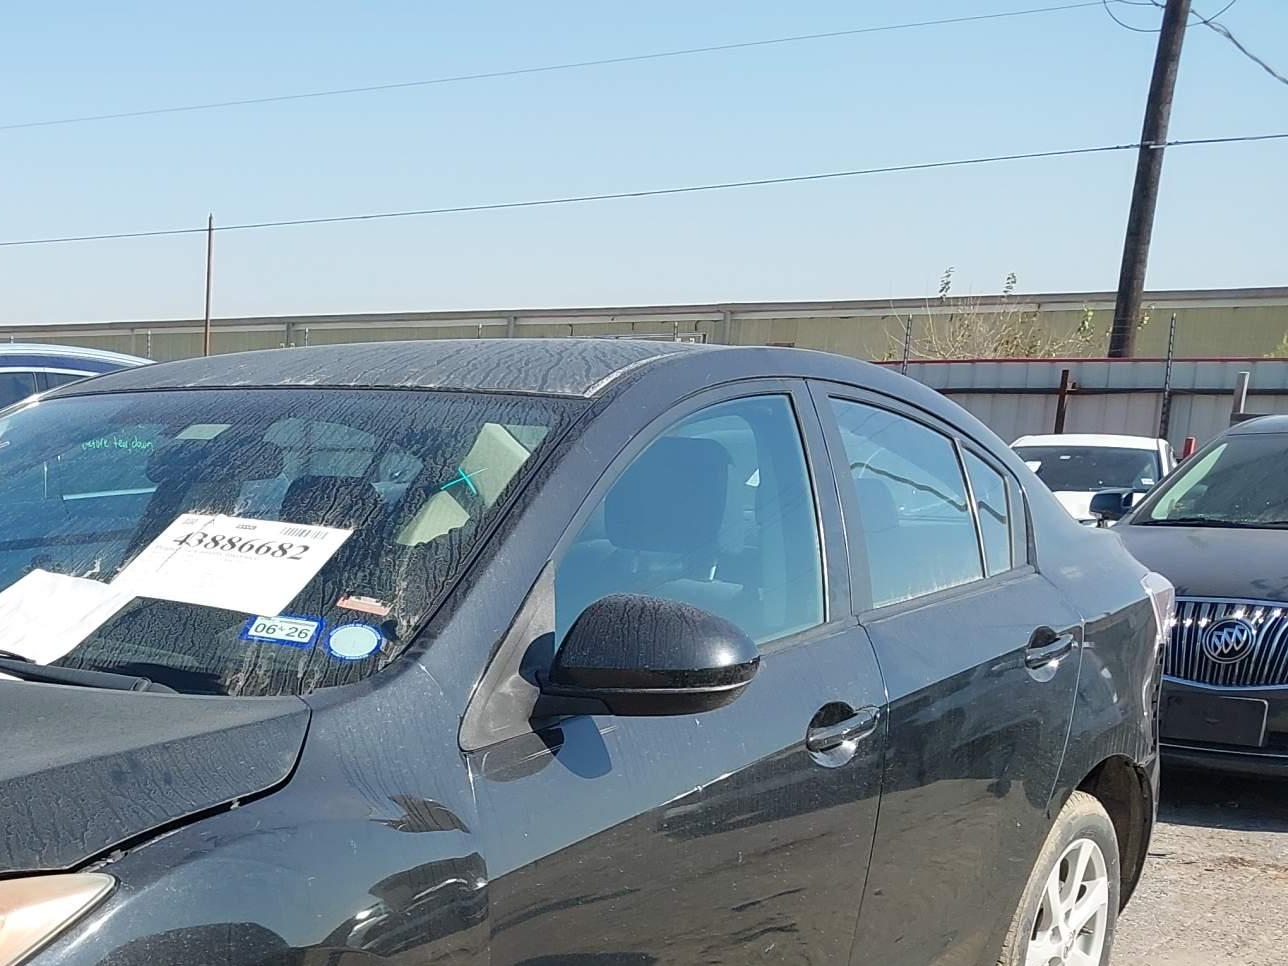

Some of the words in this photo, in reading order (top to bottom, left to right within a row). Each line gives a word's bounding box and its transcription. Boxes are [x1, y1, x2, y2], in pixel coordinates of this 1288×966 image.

[173, 531, 310, 561] 43886682
[254, 622, 278, 635] 06
[285, 626, 311, 639] 26
